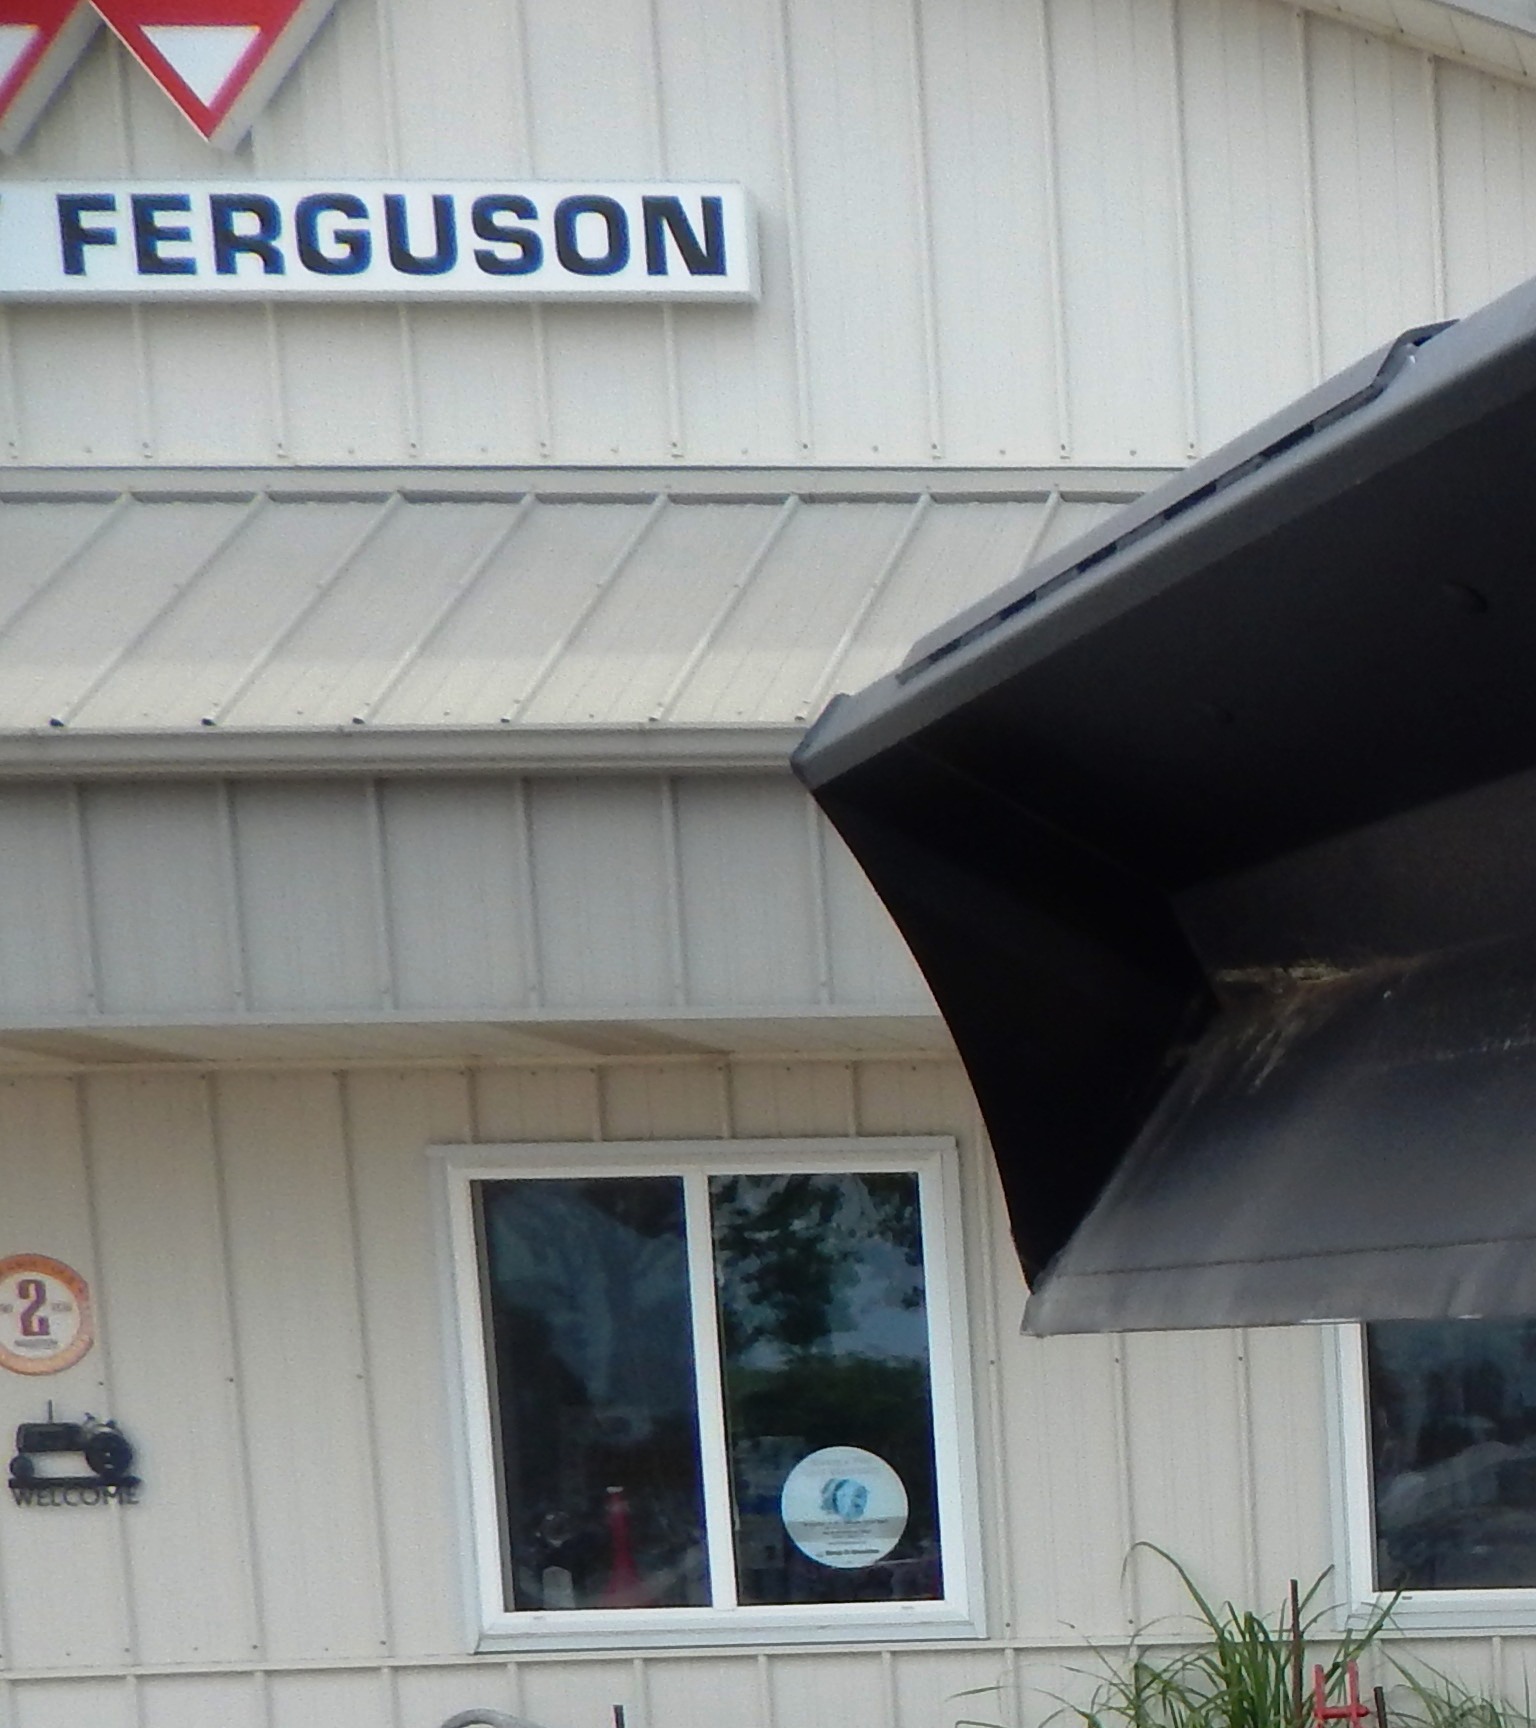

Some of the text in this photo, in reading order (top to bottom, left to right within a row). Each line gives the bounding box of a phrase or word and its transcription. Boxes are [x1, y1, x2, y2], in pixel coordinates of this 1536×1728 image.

[55, 193, 728, 277] FERGUSON
[17, 1279, 51, 1337] 2
[12, 1486, 140, 1506] WELCOME
